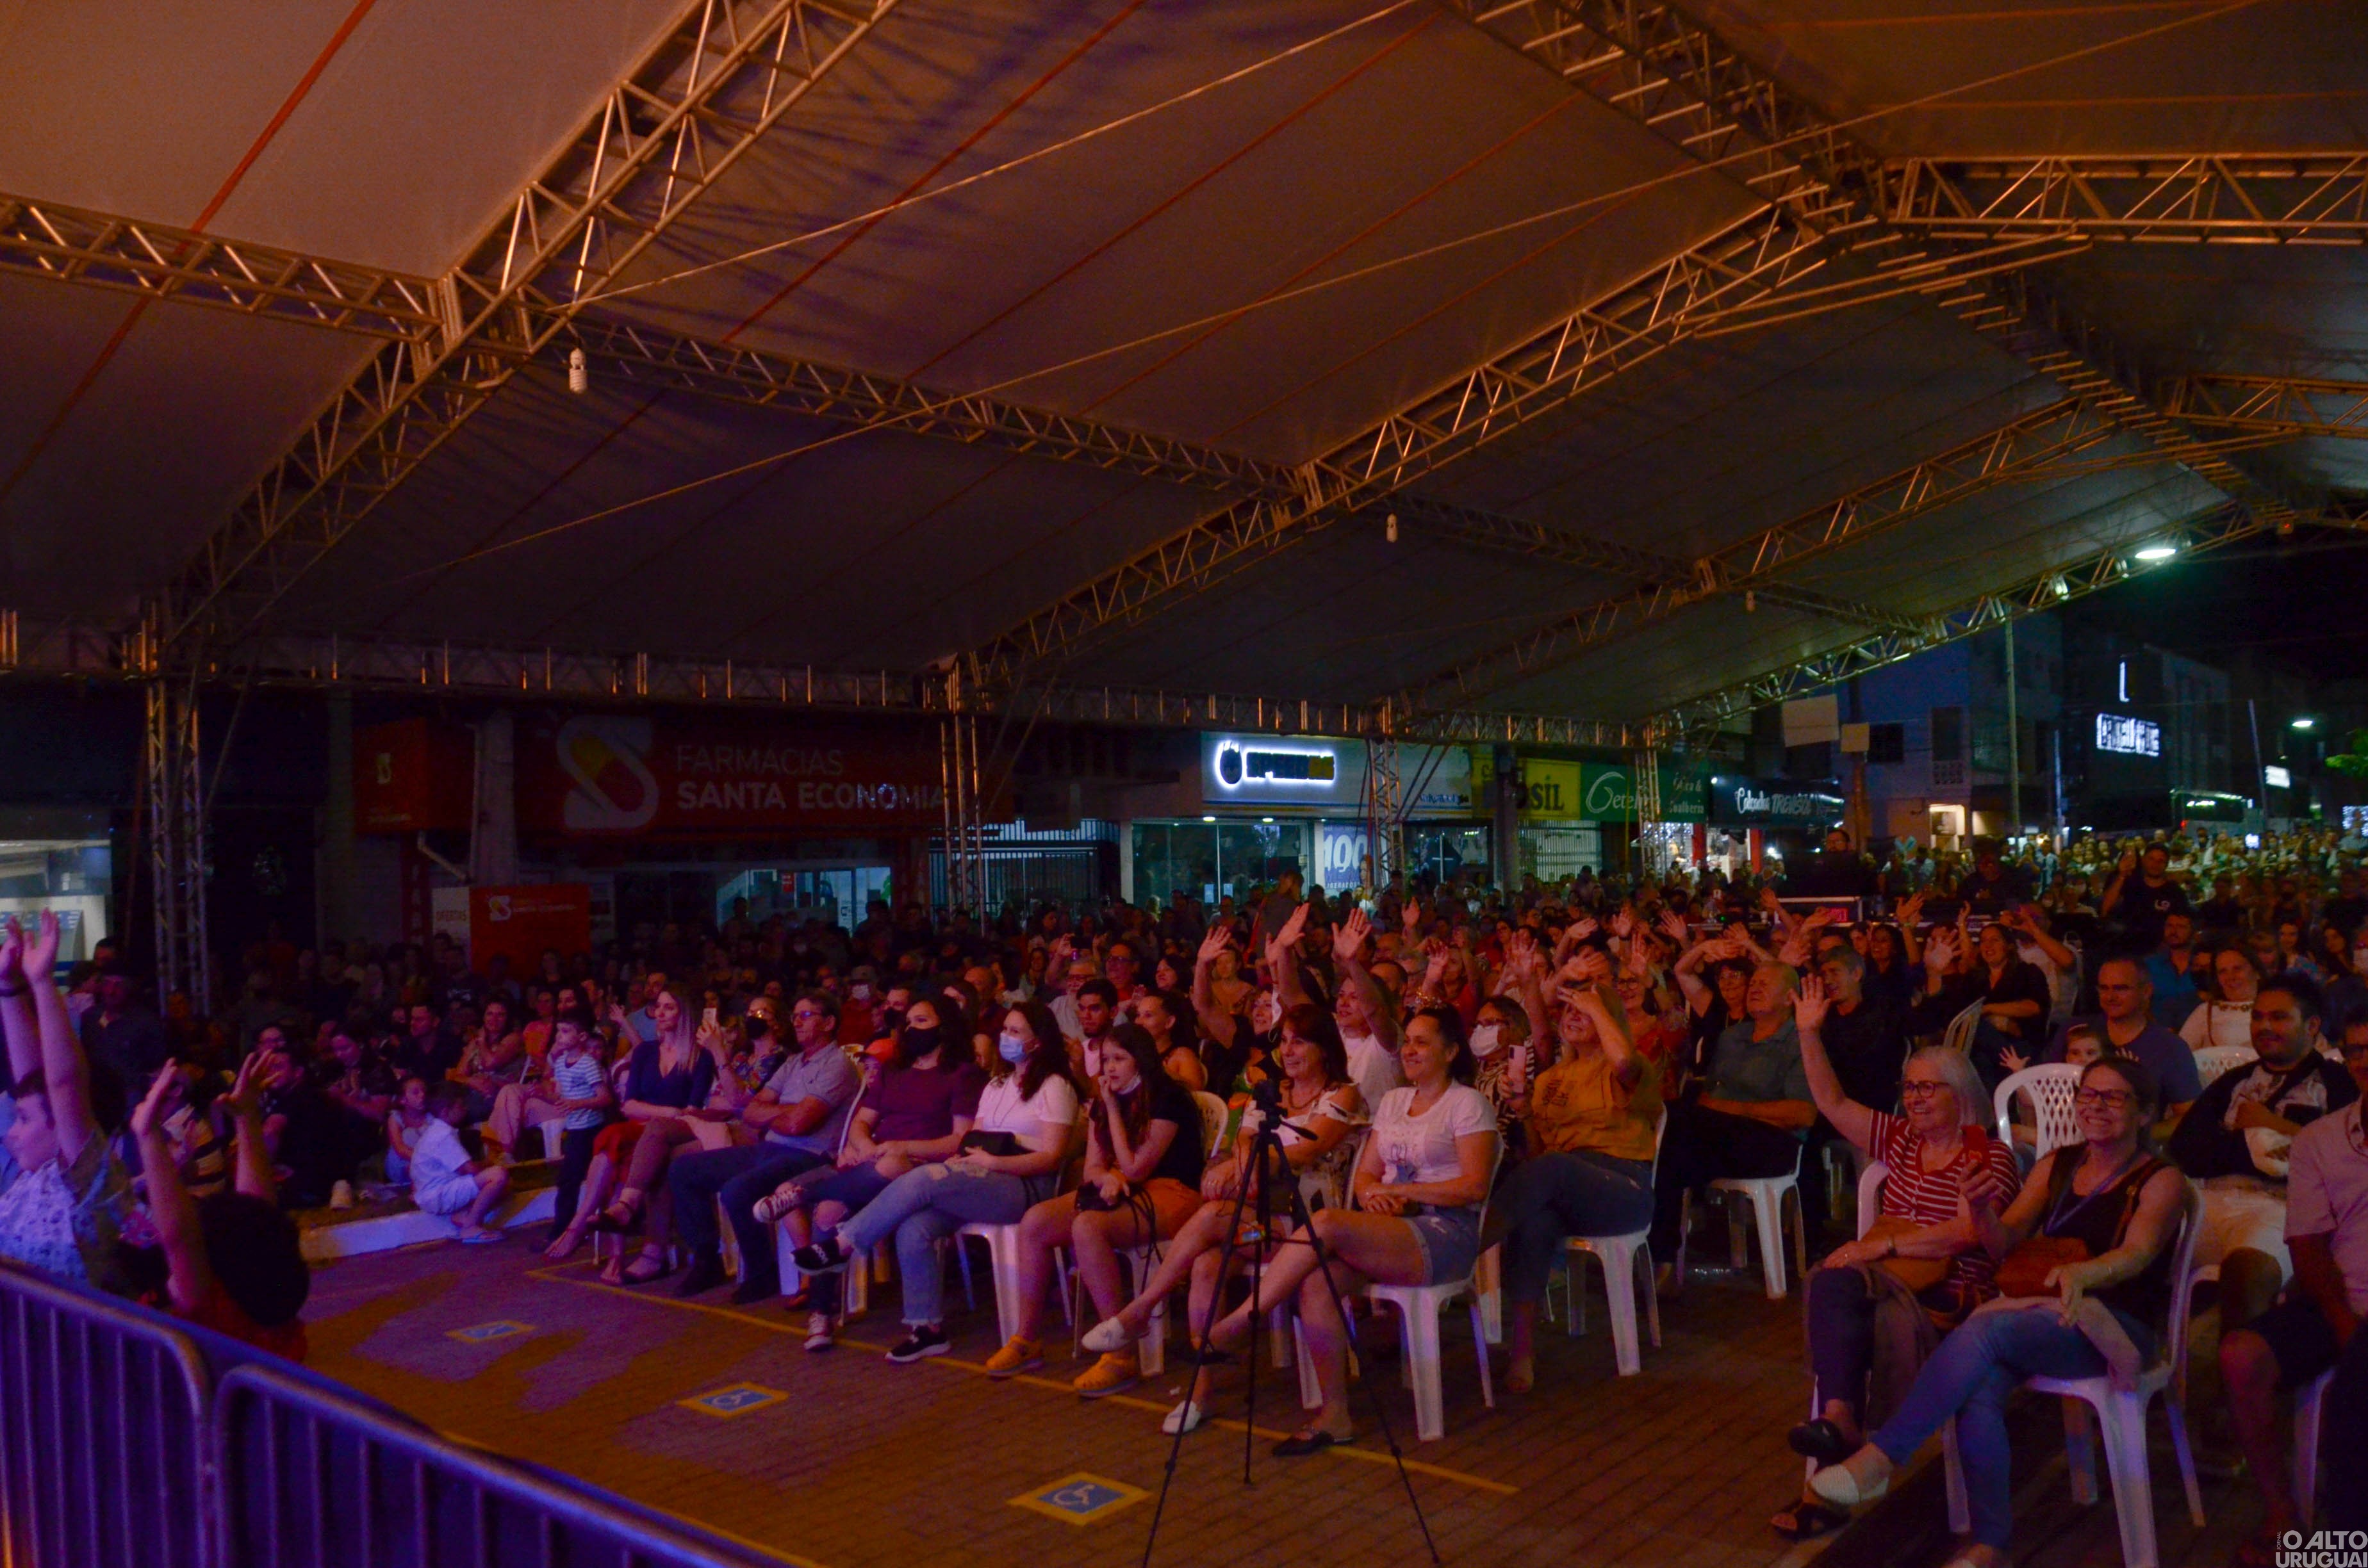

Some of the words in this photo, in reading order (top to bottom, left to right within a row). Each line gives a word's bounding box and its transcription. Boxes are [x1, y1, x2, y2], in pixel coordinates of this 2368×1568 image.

[677, 780, 787, 810] SANTA
[798, 781, 947, 810] ECONOMIA
[1324, 834, 1368, 872] 100
